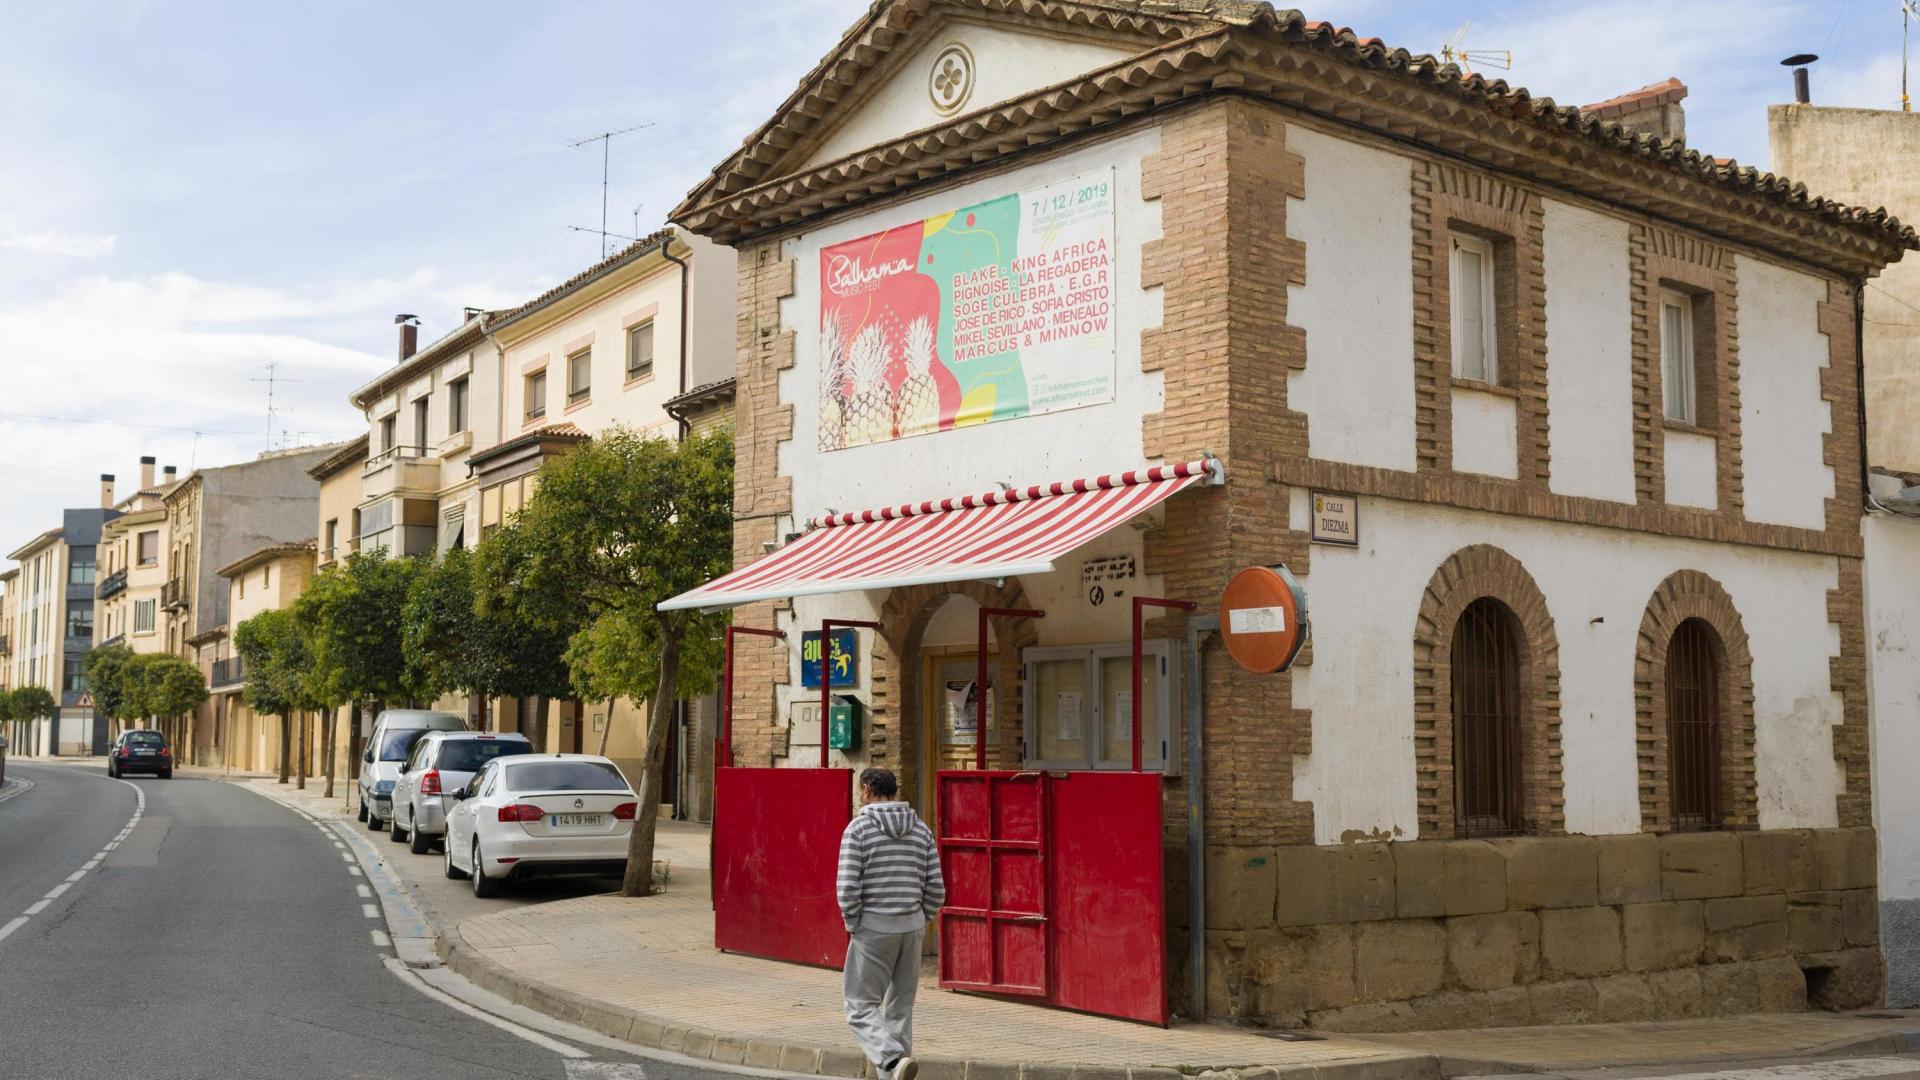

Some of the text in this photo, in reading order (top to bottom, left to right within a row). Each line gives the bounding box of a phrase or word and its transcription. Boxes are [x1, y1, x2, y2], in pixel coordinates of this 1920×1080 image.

[1032, 201, 1040, 216] 7
[1052, 194, 1066, 210] 12
[1078, 182, 1108, 203] 2019
[954, 238, 1107, 287] BLAKE KING AFRICA
[954, 254, 1109, 302] PIGNOISE LA REGADERA
[864, 279, 881, 292] FEST
[954, 270, 1107, 318] SOGE CULEBRA E.G.R
[953, 286, 1109, 333] JOSE DE RICO SOFIA CRISTO
[954, 302, 1109, 347] MIKEL SEVILLANO MENEALO
[954, 317, 1108, 361] MARCUS & MINNOW
[1322, 518, 1350, 534] DIEZMA
[1326, 502, 1344, 513] CALLE
[560, 815, 601, 825] 1419 HHT
